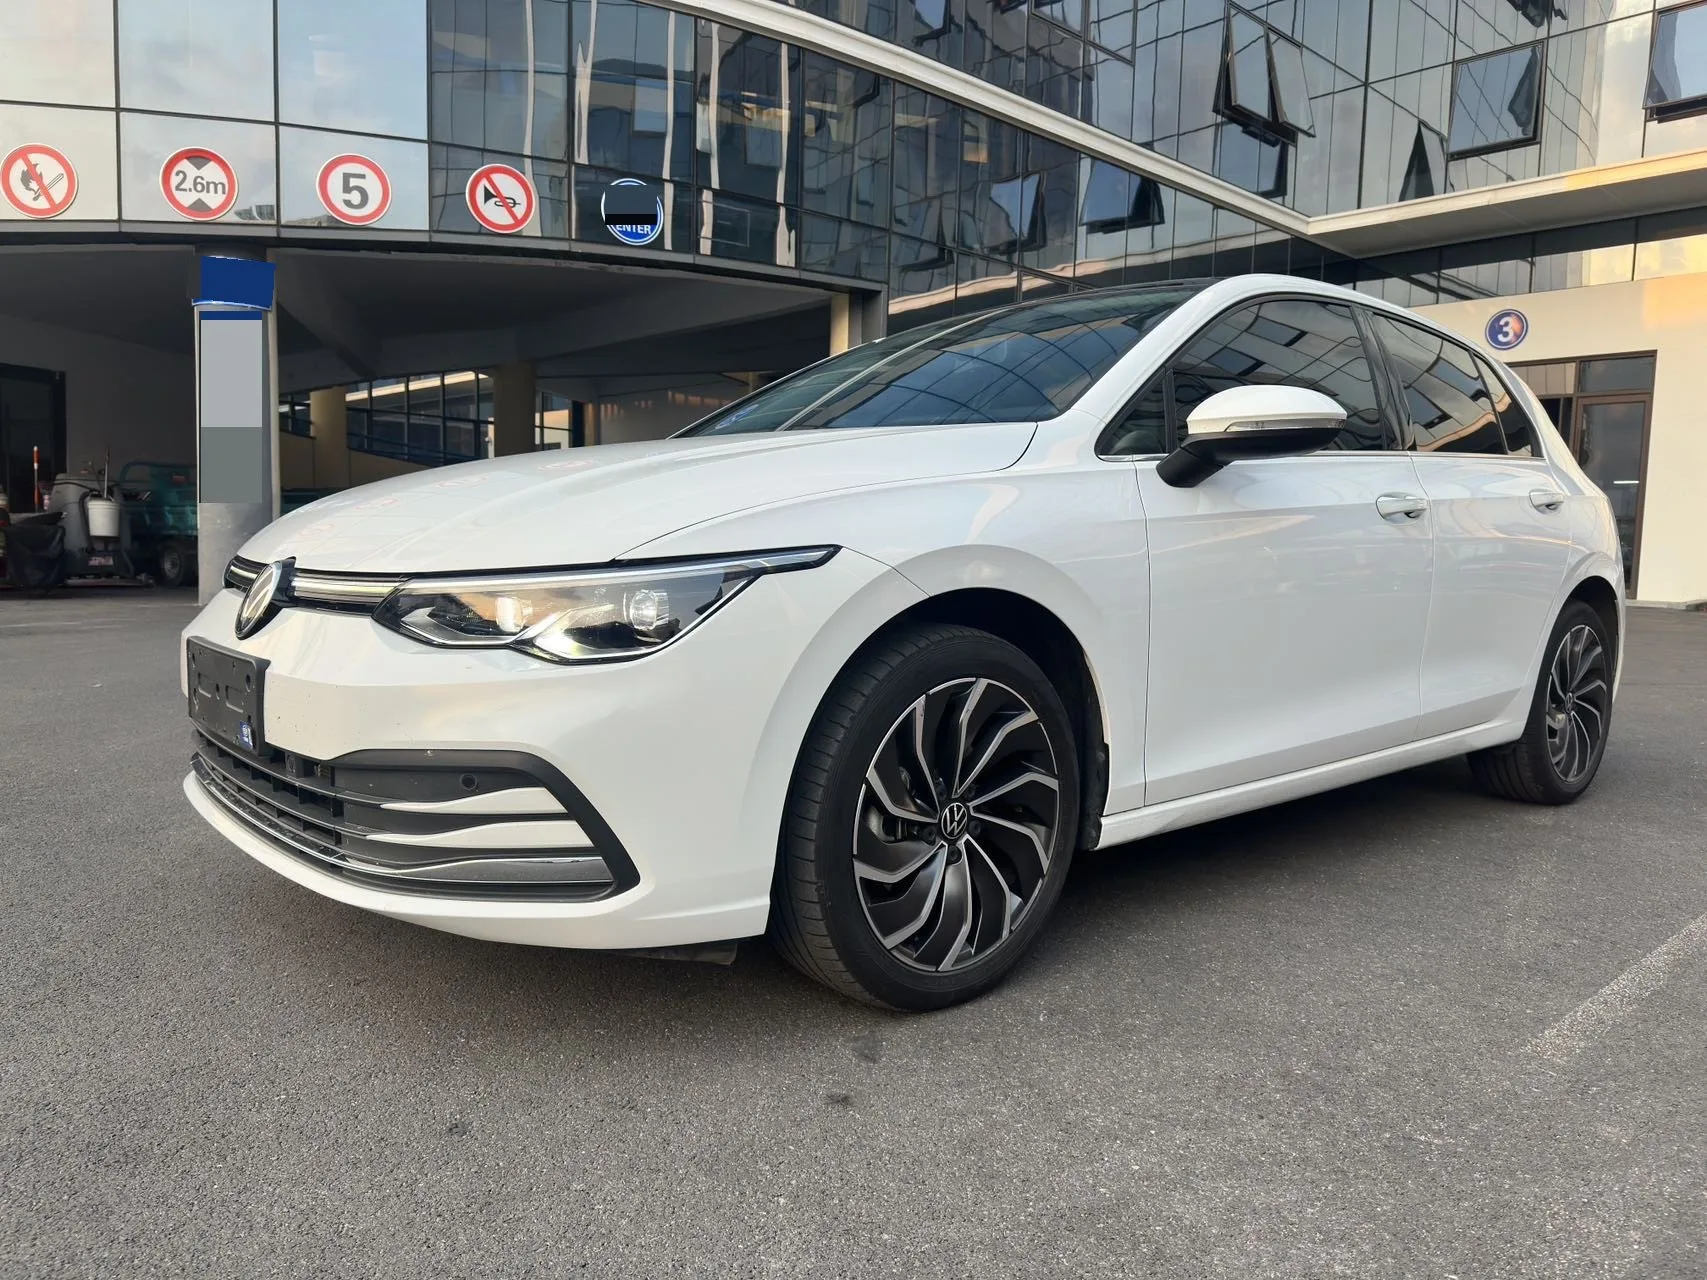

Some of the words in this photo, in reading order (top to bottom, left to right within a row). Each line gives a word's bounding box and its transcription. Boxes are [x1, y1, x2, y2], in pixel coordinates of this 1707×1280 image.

[175, 170, 226, 195] 2.6m
[342, 172, 369, 210] 5
[1497, 316, 1515, 343] 3
